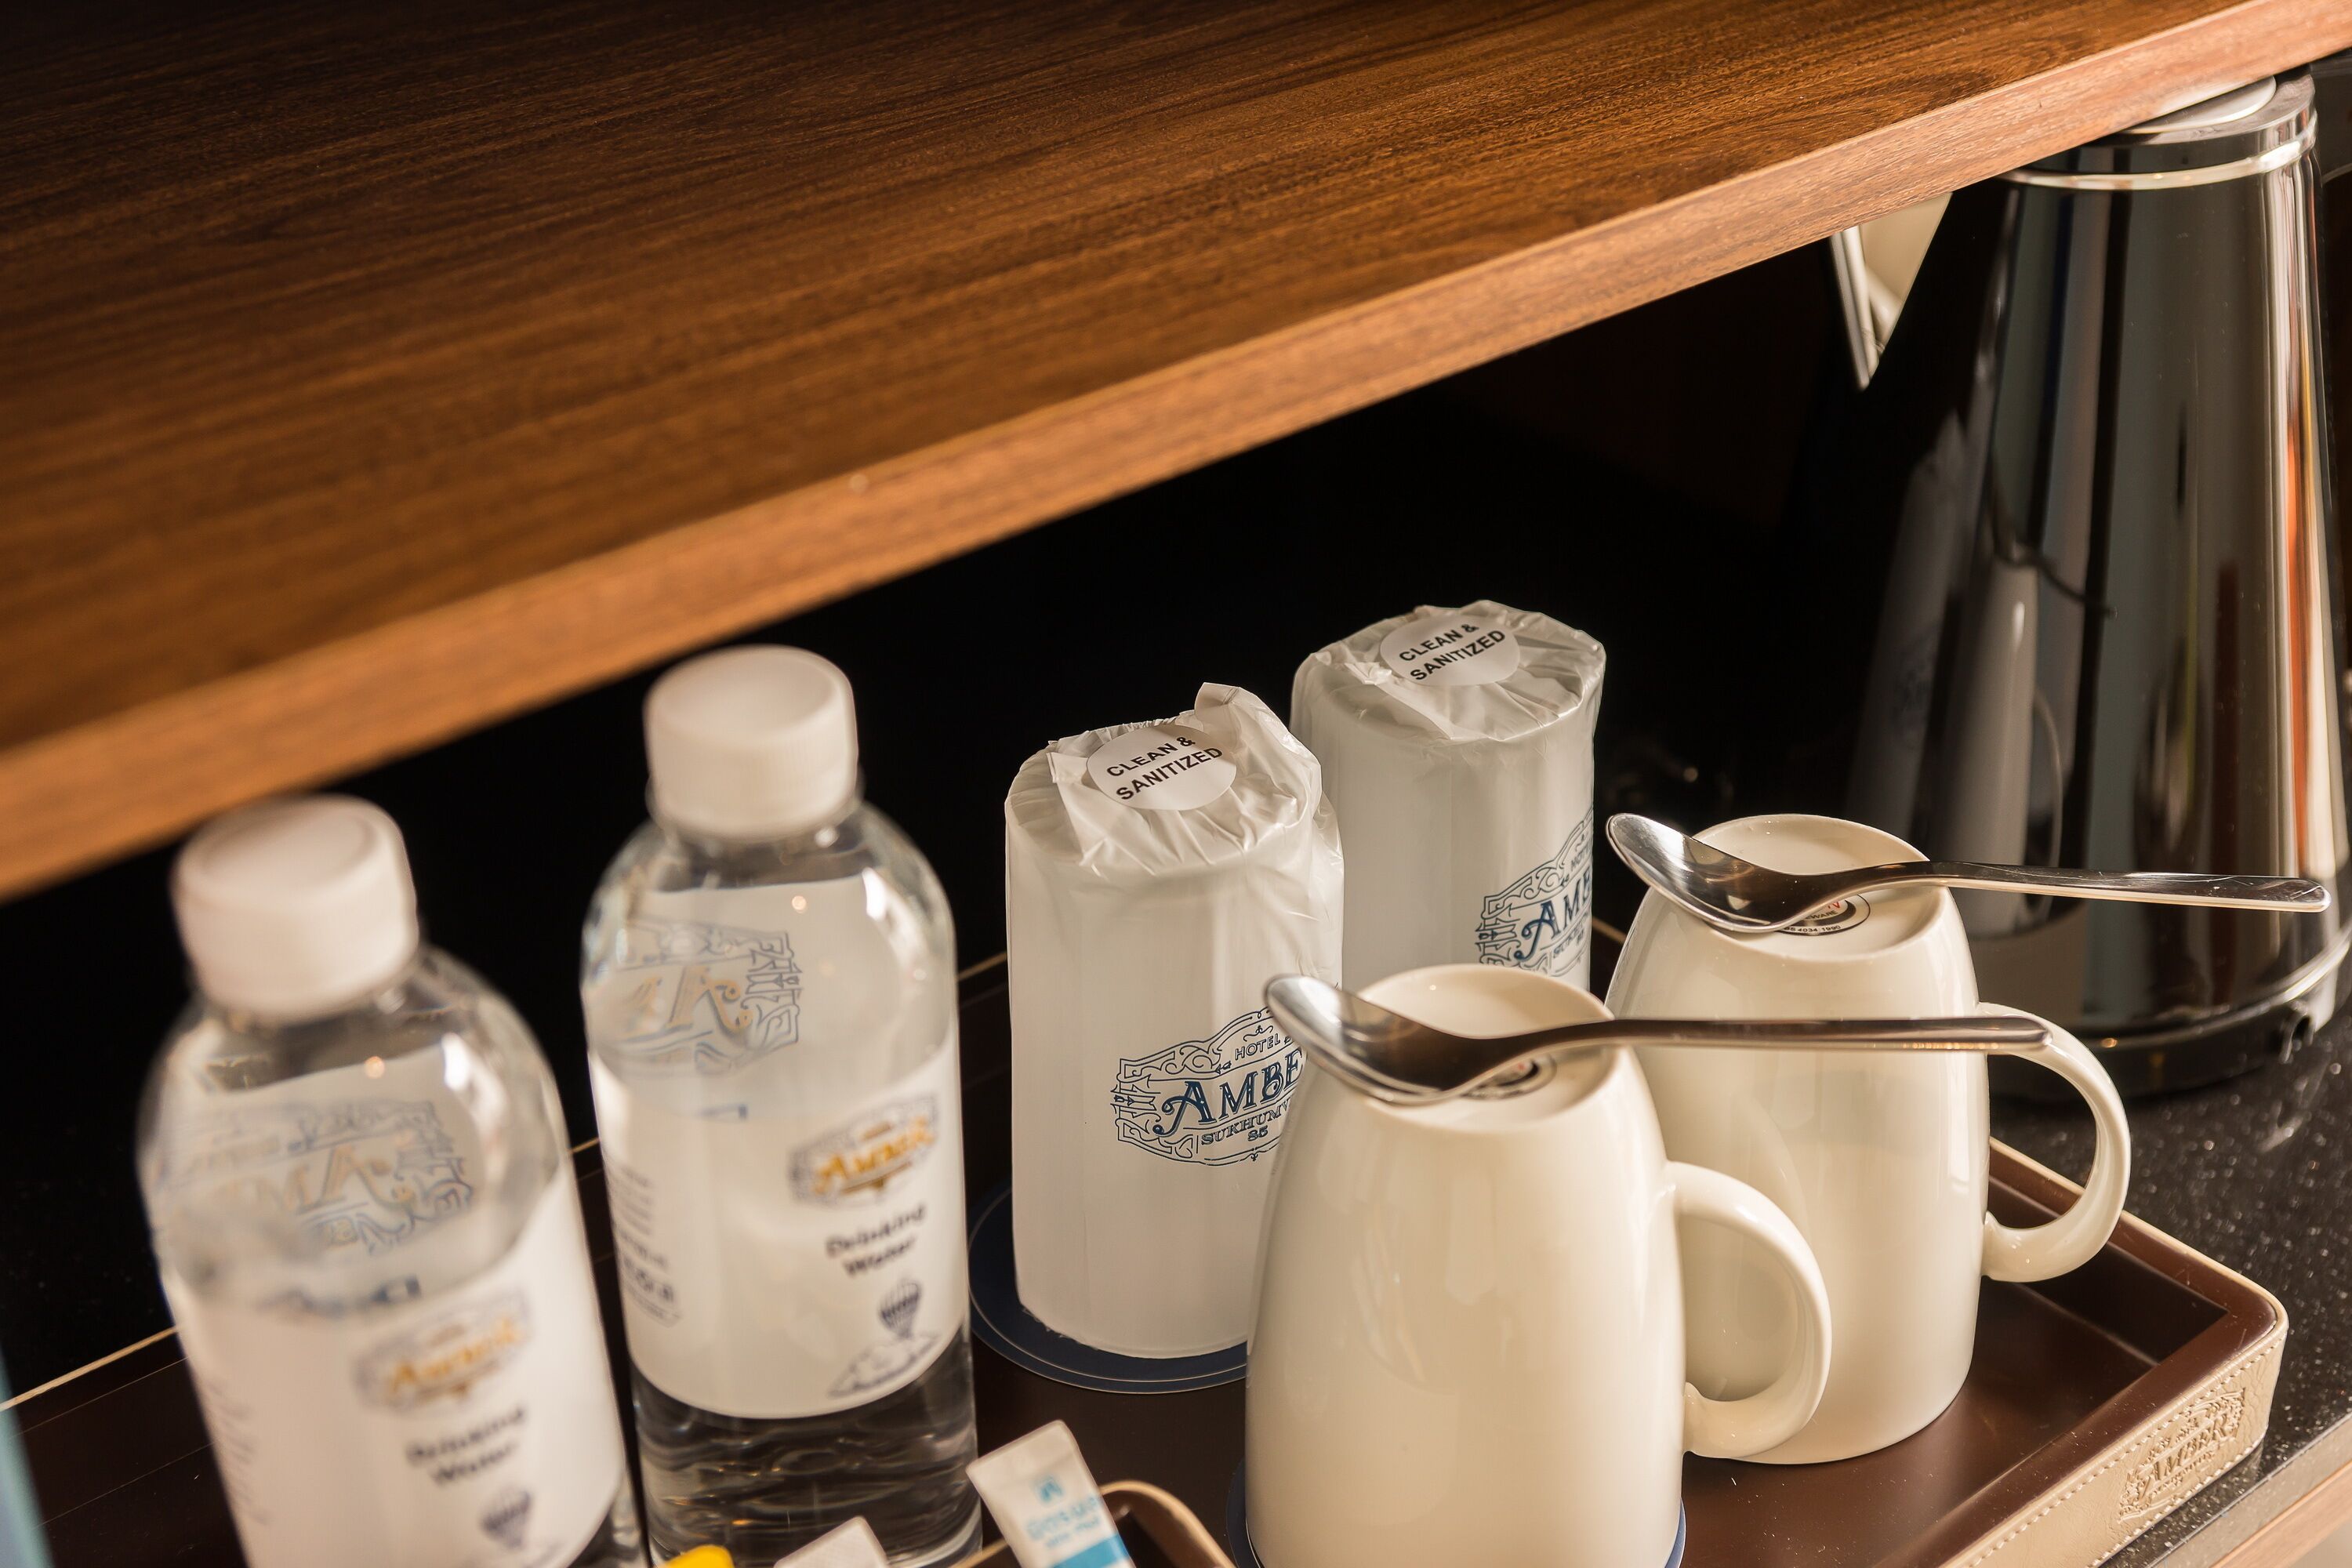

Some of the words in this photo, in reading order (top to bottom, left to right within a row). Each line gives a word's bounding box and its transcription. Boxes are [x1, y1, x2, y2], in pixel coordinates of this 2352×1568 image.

[1399, 630, 1464, 662] CLEAN
[1461, 623, 1479, 633] &
[1410, 630, 1505, 681] SANITIZED
[1106, 742, 1178, 777] CLEAN
[1176, 736, 1196, 747] &
[1116, 747, 1223, 800] SANITIZED
[1235, 1033, 1281, 1061] HOTEL
